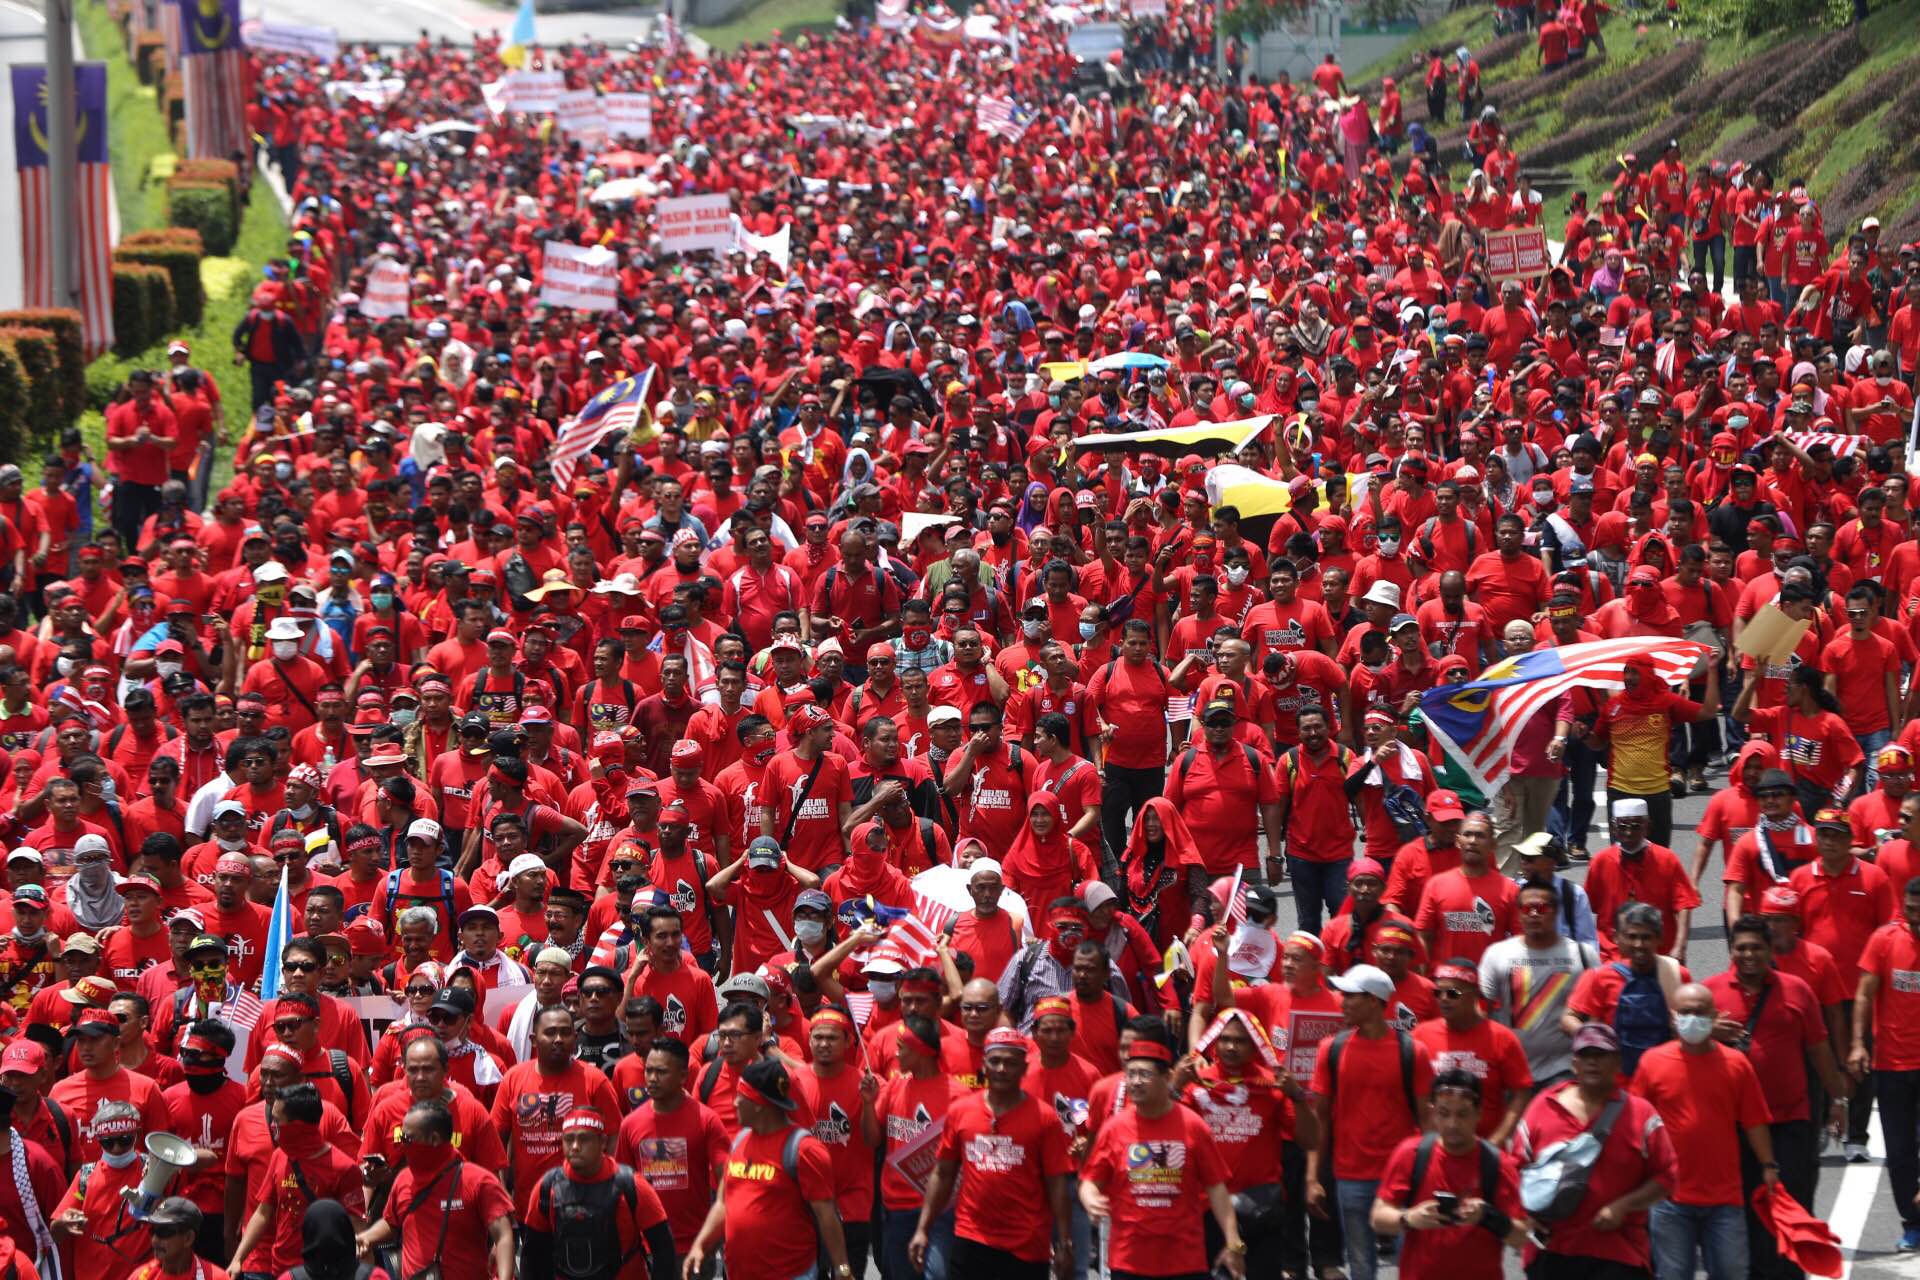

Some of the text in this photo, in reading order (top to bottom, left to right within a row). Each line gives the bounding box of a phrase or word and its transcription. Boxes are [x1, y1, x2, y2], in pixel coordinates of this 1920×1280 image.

[1077, 494, 1095, 503] JACK
[979, 797, 1011, 805] BERSATU
[727, 1160, 775, 1181] MELAYU
